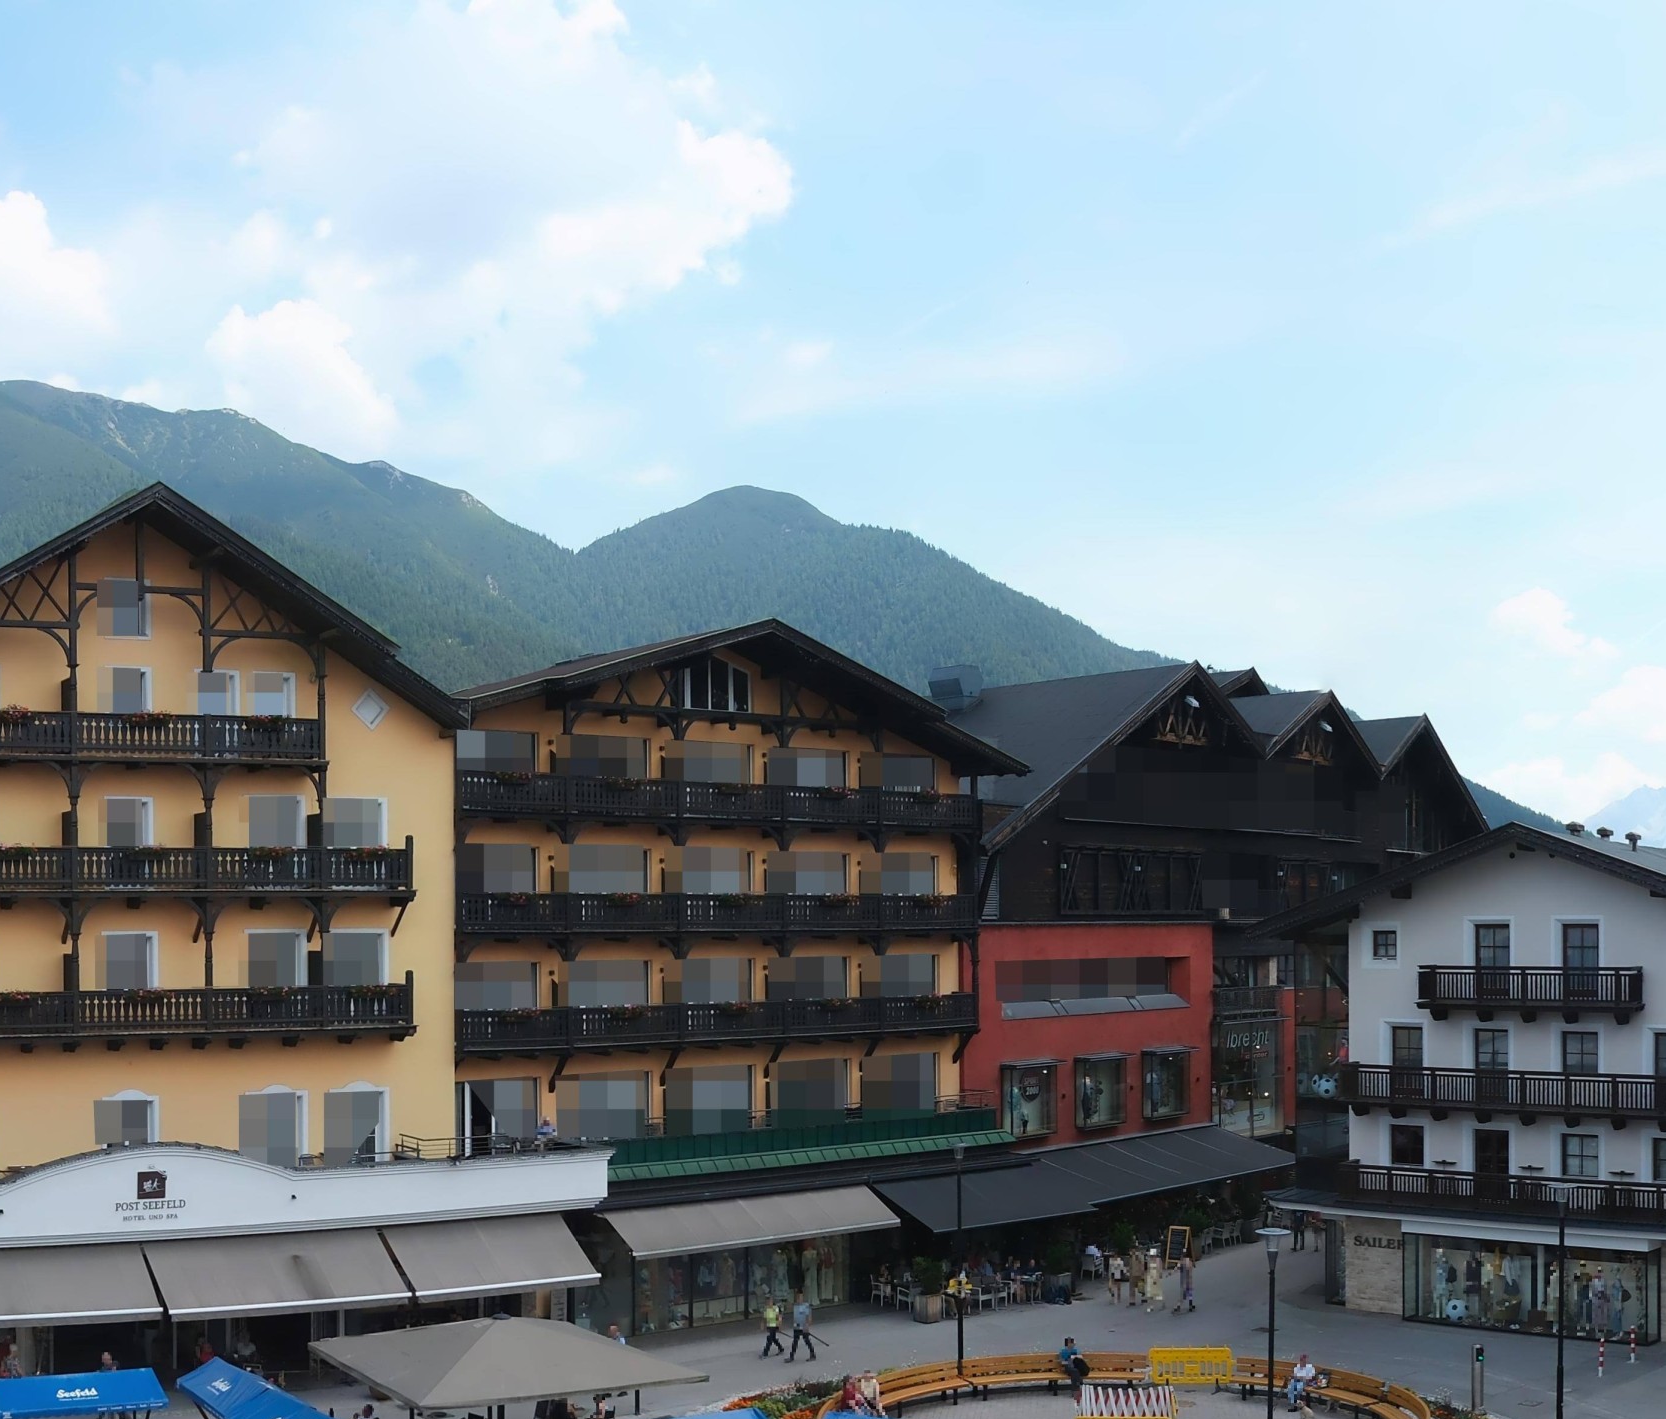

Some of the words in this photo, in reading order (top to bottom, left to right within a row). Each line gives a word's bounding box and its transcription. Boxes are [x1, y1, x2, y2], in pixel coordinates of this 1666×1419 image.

[115, 1201, 140, 1212] POST
[142, 1199, 186, 1211] SEEFELD
[56, 1386, 98, 1399] Seefeld
